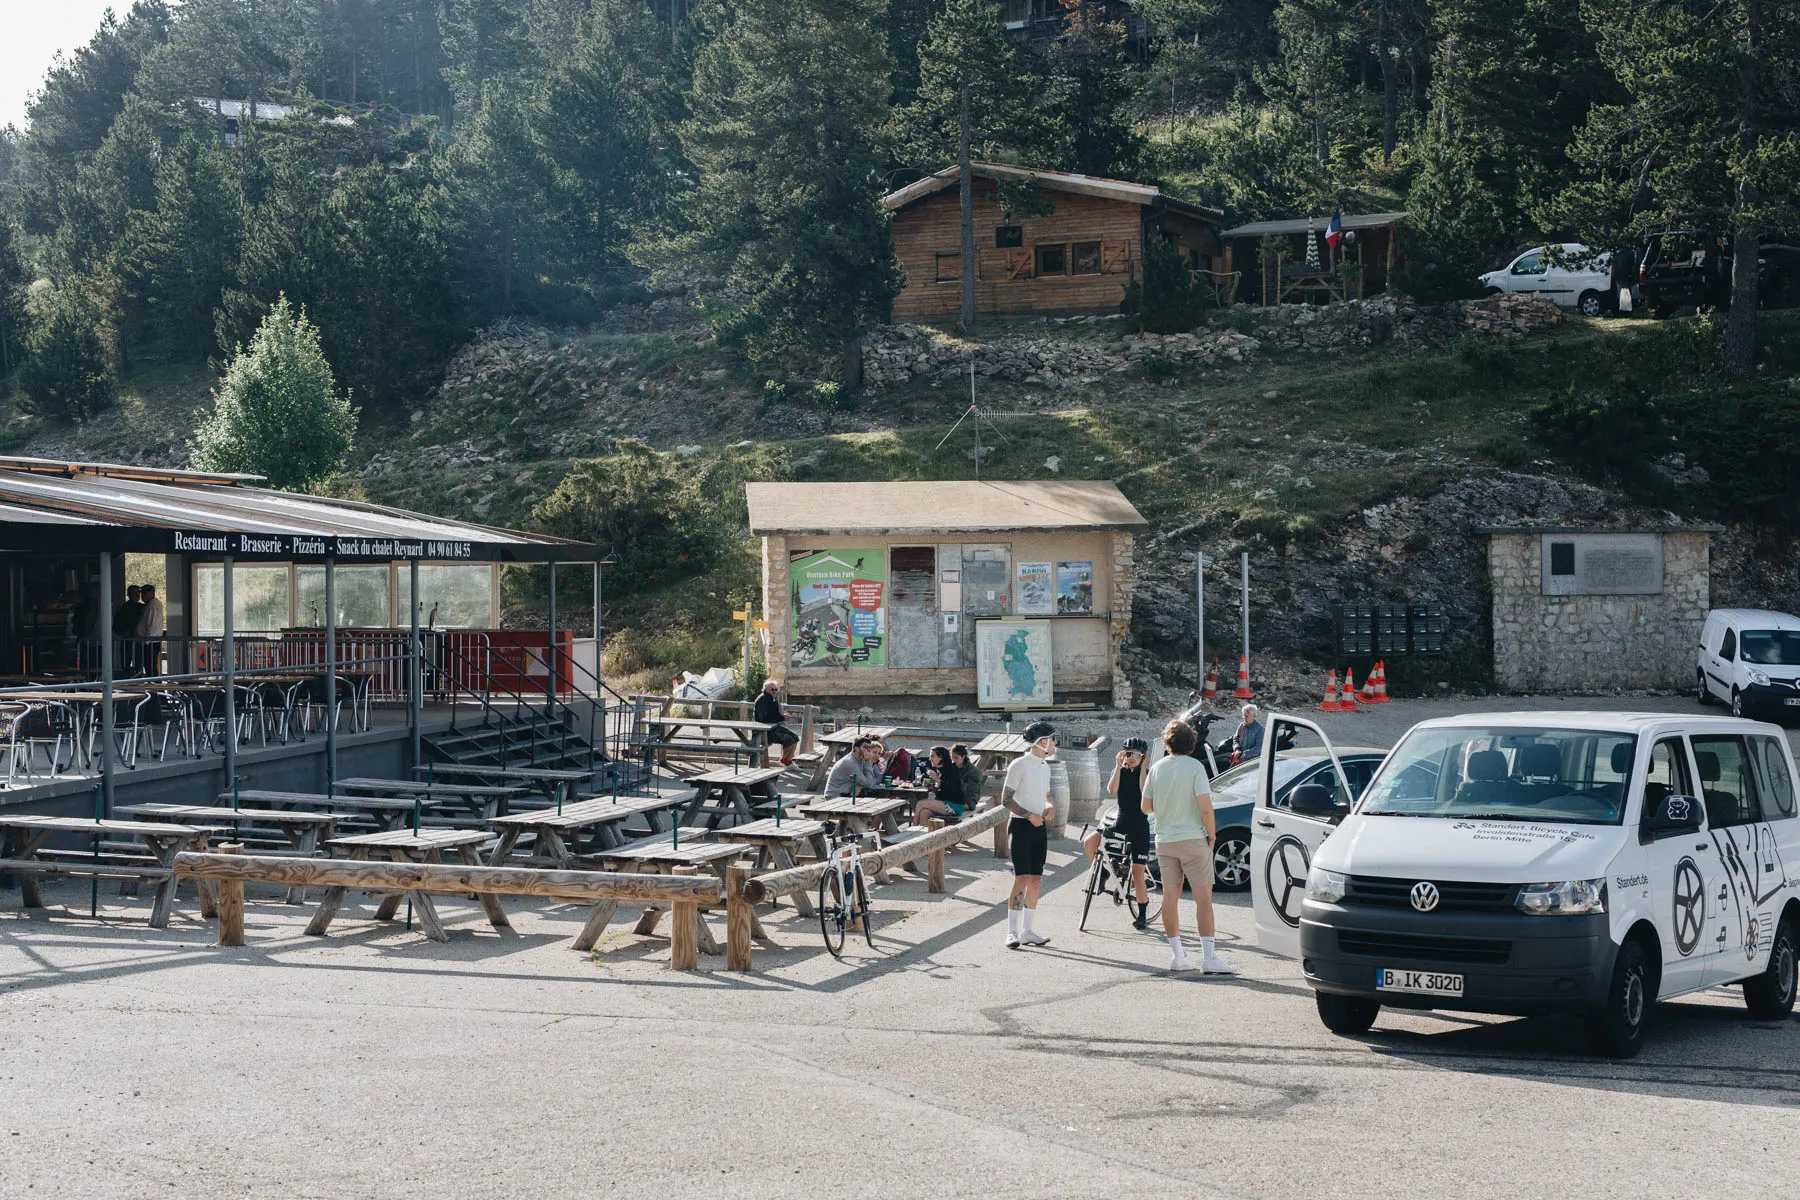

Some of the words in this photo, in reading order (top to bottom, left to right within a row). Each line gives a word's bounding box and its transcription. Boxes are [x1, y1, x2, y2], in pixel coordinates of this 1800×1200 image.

[174, 531, 228, 551] Restaurant
[240, 534, 282, 553] Brasserie
[292, 536, 325, 554] Pizzéria
[336, 538, 360, 555] Snack
[361, 539, 371, 555] du
[371, 540, 393, 556] chalet
[394, 540, 423, 560] Reynard
[428, 541, 436, 557] 04
[437, 541, 445, 557] 90
[446, 542, 453, 557] 61
[454, 542, 462, 557] 84
[463, 543, 471, 558] 55
[1476, 829, 1556, 839] Invalidenstraße
[1530, 825, 1568, 835] Bicycle
[1616, 874, 1648, 889] Standert.de
[1385, 971, 1394, 986] B
[1404, 973, 1422, 988] IK
[1426, 974, 1462, 991] 3020
